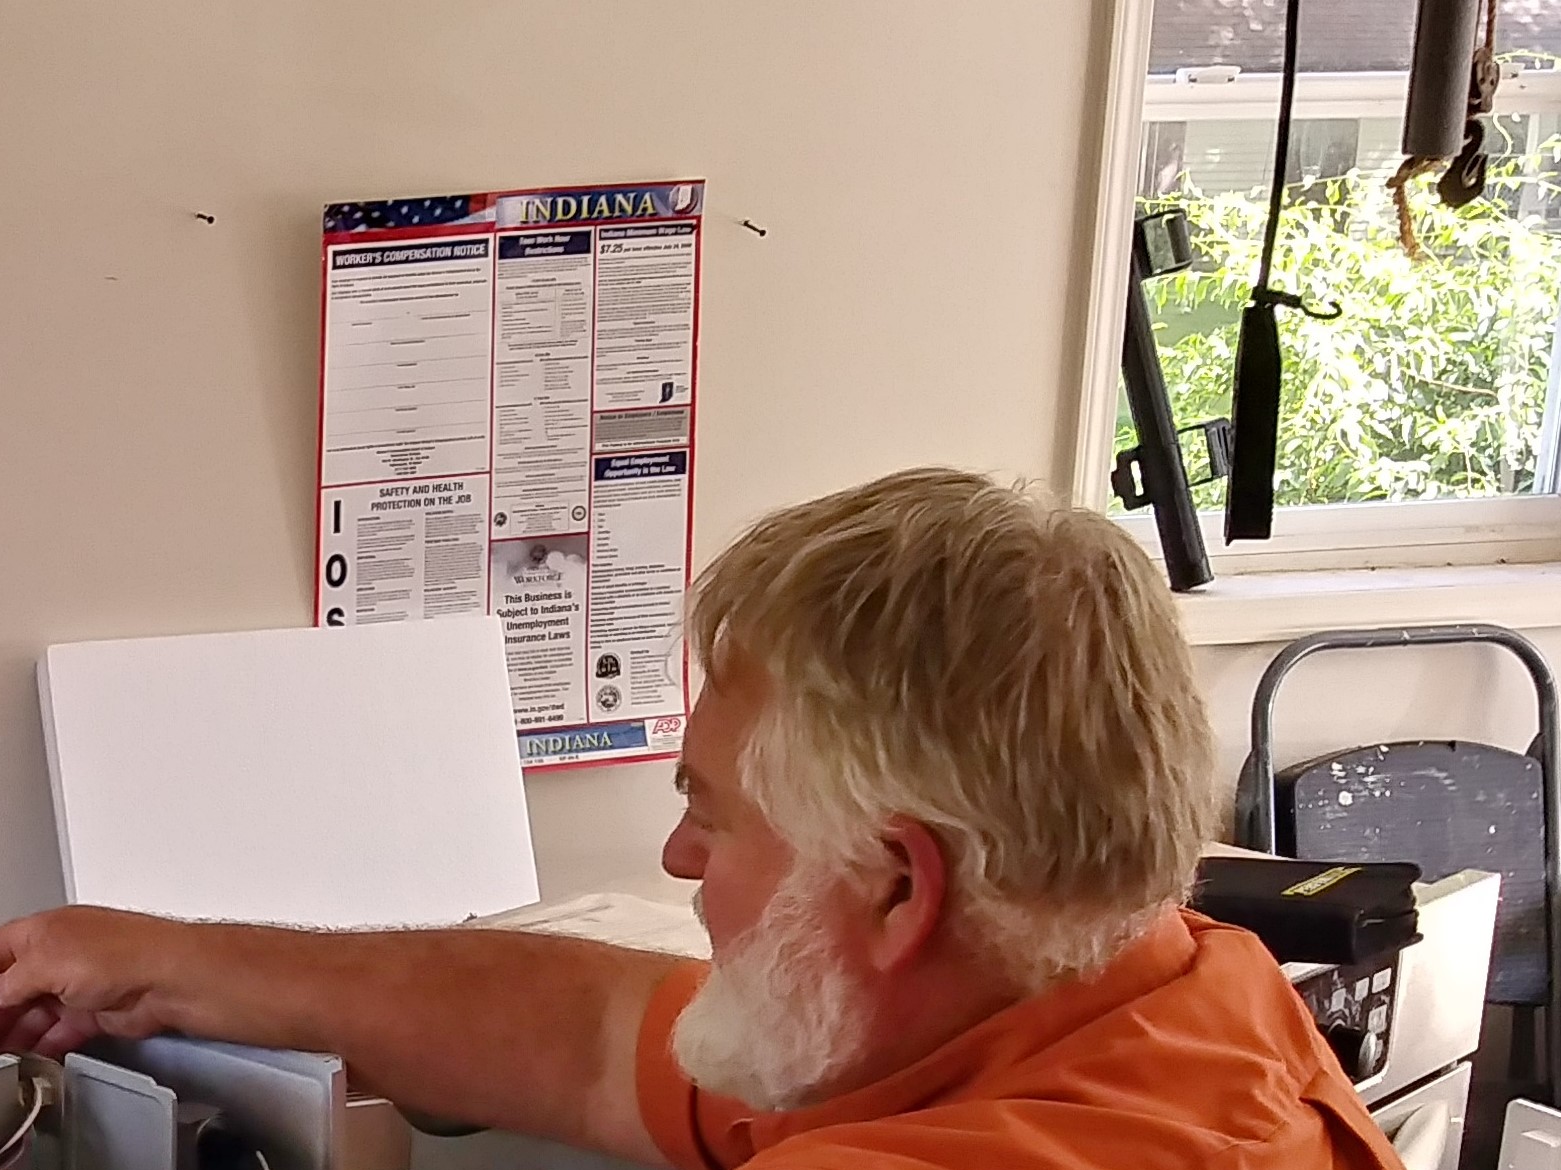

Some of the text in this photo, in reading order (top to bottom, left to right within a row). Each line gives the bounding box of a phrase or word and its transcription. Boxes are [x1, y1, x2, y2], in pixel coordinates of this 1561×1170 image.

[520, 192, 657, 223] INDIANA
[335, 244, 486, 266] WORKER'S COMPENSATION NOTICE
[600, 243, 623, 255] $7.25
[379, 482, 464, 498] SAFETY AND HEALTH
[370, 494, 472, 512] PROTECTION ON THE JOB
[504, 590, 572, 604] This Business is
[496, 603, 580, 619] Subject to Indiana's
[506, 617, 569, 631] Unemployment
[505, 631, 571, 645] Insurance Laws
[652, 717, 681, 735] ADP
[526, 732, 613, 756] INDIANA
